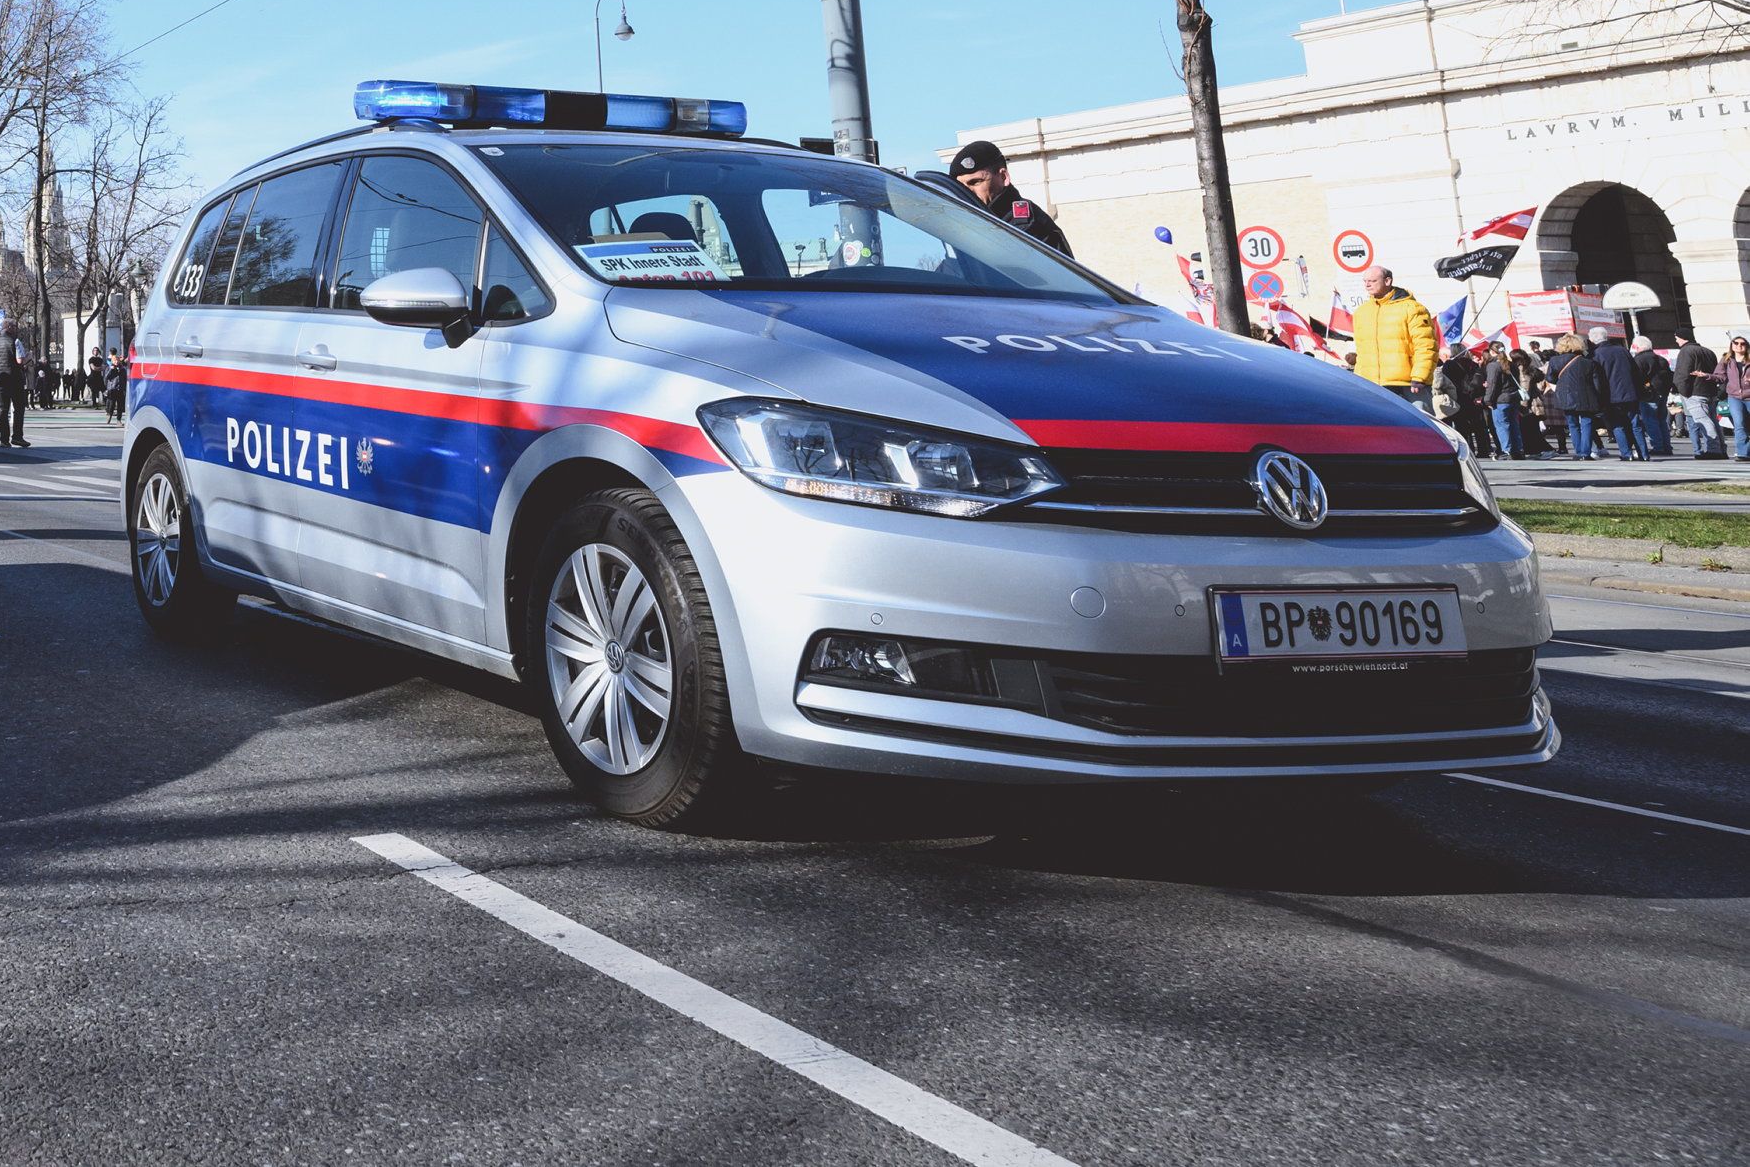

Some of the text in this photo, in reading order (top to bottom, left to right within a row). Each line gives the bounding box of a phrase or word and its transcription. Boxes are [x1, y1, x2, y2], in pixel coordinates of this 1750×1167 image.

[1247, 237, 1272, 258] 30
[600, 255, 706, 272] SPK Innere Stadt
[181, 264, 204, 298] 133
[941, 334, 1254, 362] POLIZEI
[226, 417, 350, 490] POLIZEI
[1232, 635, 1242, 648] A
